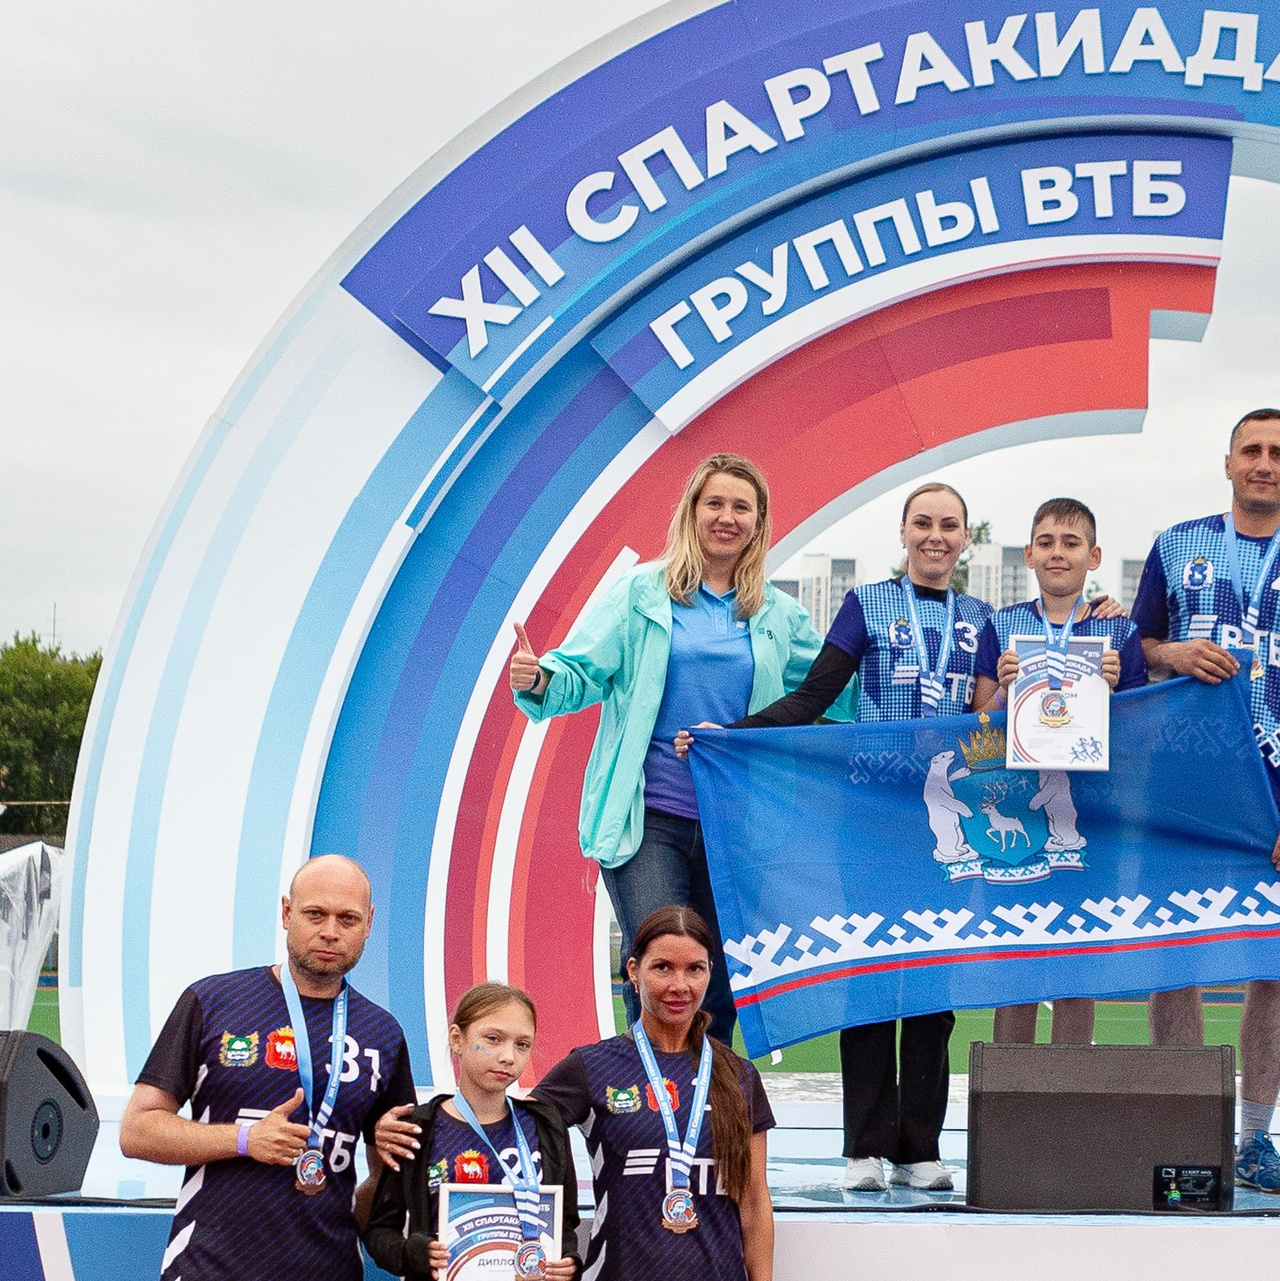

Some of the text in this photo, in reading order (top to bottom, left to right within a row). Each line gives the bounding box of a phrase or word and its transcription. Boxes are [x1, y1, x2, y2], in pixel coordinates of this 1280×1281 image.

[428, 223, 564, 358] XII
[646, 159, 1187, 370] ГРУППЫ ВТБ
[954, 621, 979, 654] 3
[325, 1033, 382, 1093] 31
[318, 1127, 357, 1173] ТБ
[478, 1258, 515, 1267] ДИПЛО
